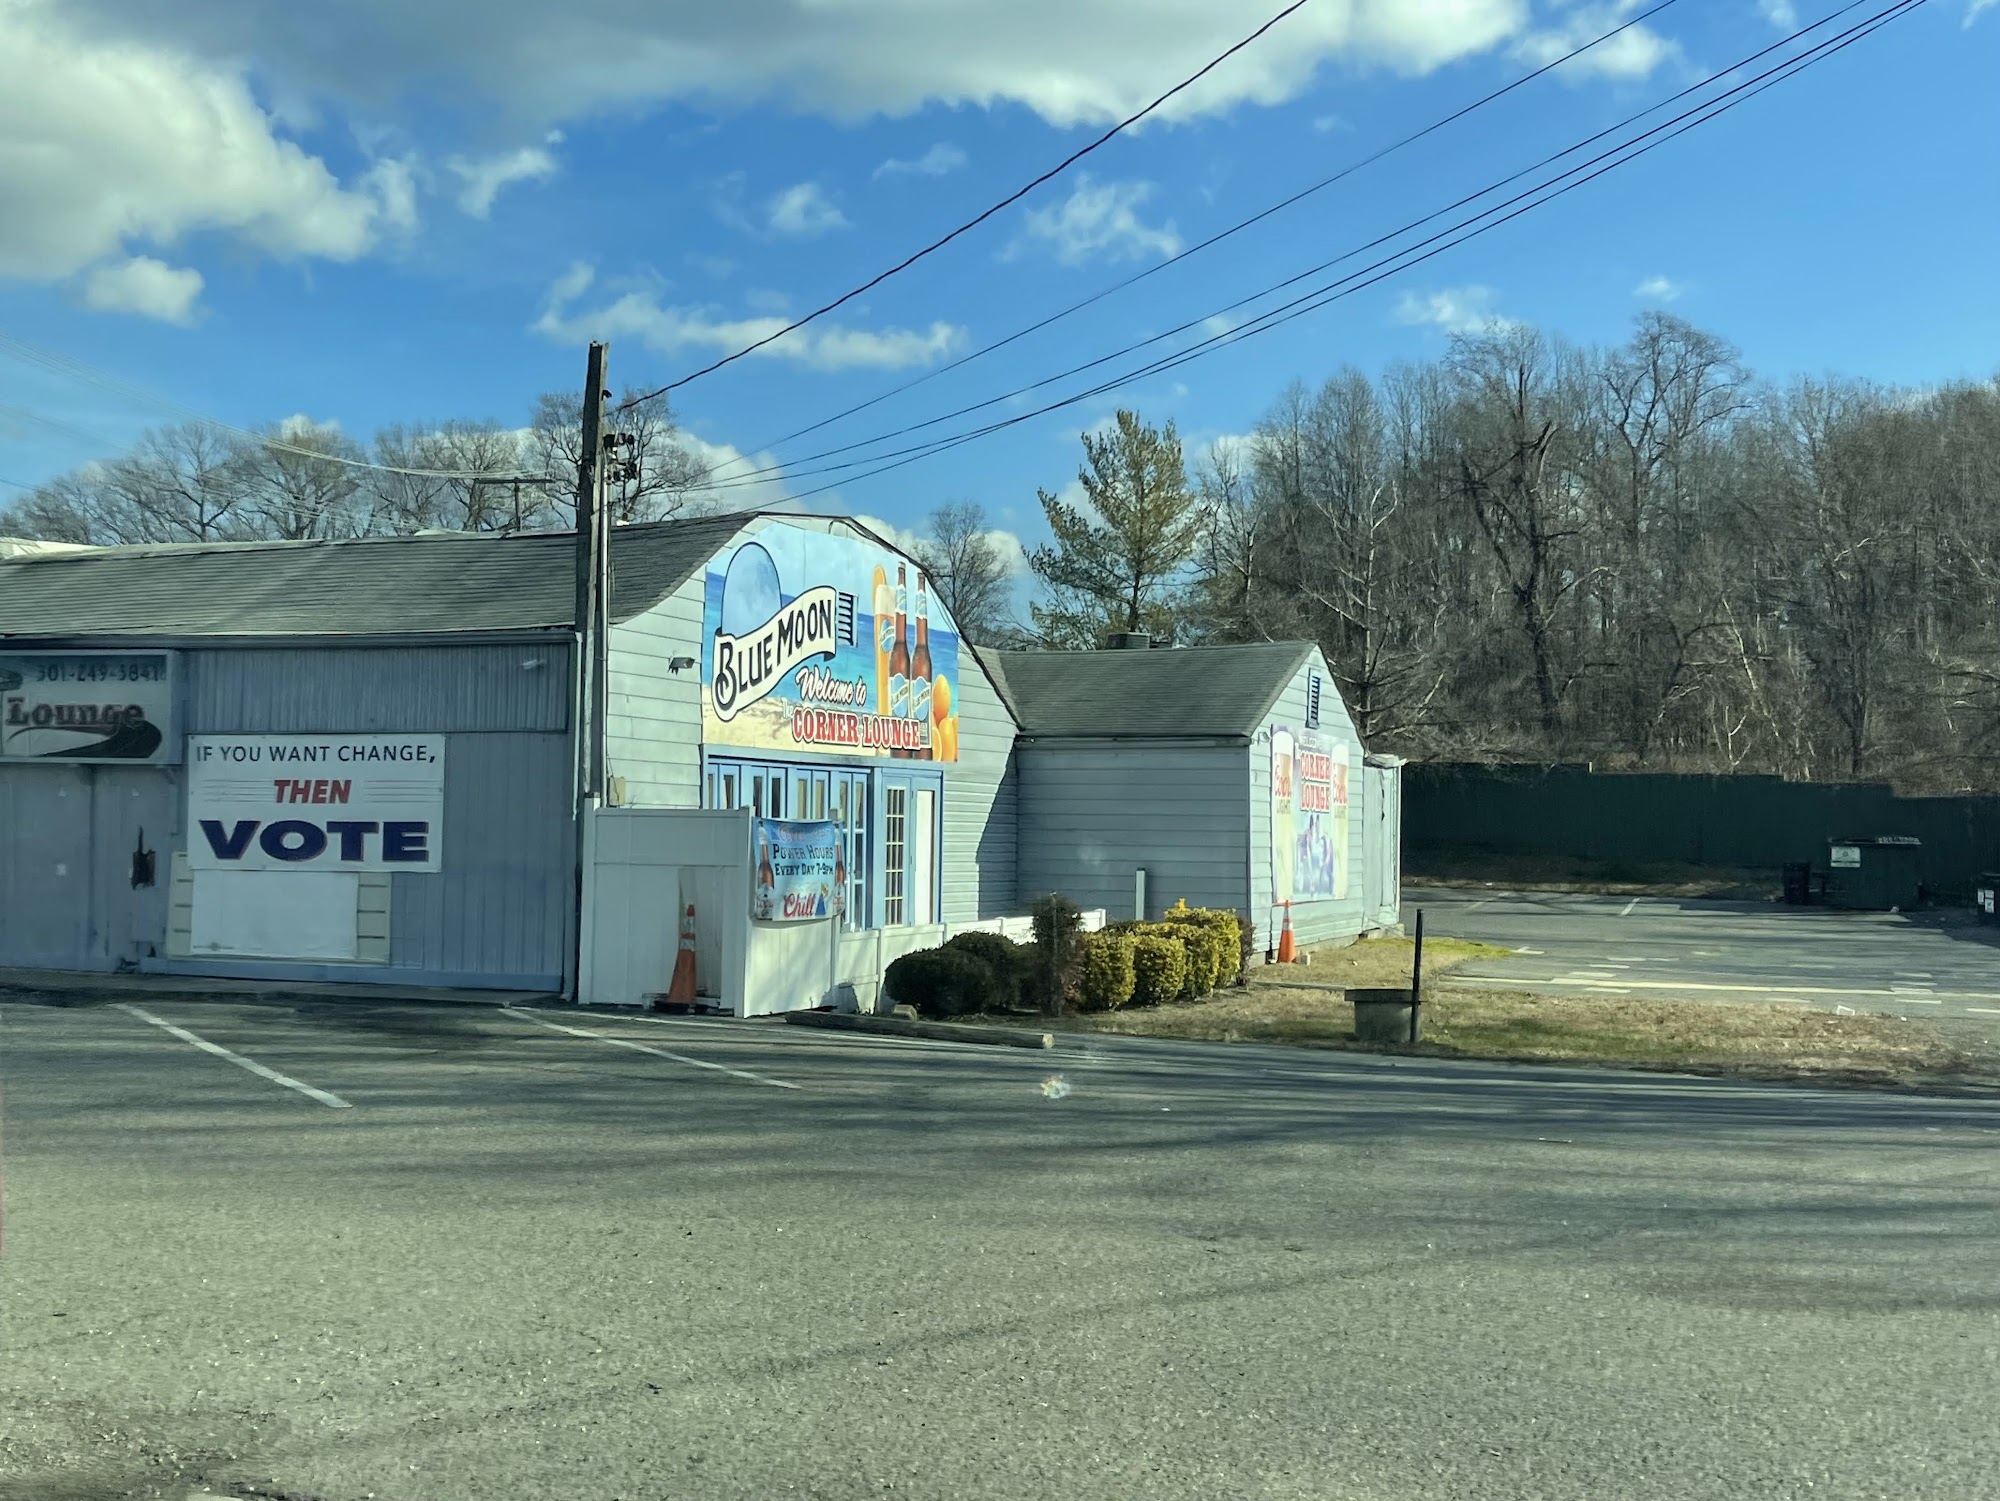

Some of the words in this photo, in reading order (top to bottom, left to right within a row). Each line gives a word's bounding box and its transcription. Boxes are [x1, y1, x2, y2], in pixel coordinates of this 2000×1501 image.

[716, 641, 773, 711] BLUE
[777, 599, 832, 667] MOON
[796, 664, 854, 706] Welcome
[855, 675, 867, 706] to
[6, 697, 145, 737] Lounge
[793, 708, 859, 744] CORNER
[863, 715, 920, 749] LOUNGE
[197, 746, 212, 762] IF
[219, 746, 261, 762] YOU
[269, 746, 330, 762] WANT
[338, 745, 436, 763] CHANGE,
[1301, 752, 1331, 780] CORNER
[274, 779, 352, 804] THEN
[1301, 784, 1330, 810] LOUNGE
[198, 820, 430, 862] VOTE
[775, 863, 800, 876] EVERY
[801, 863, 815, 875] DAY
[783, 893, 816, 918] Chill
